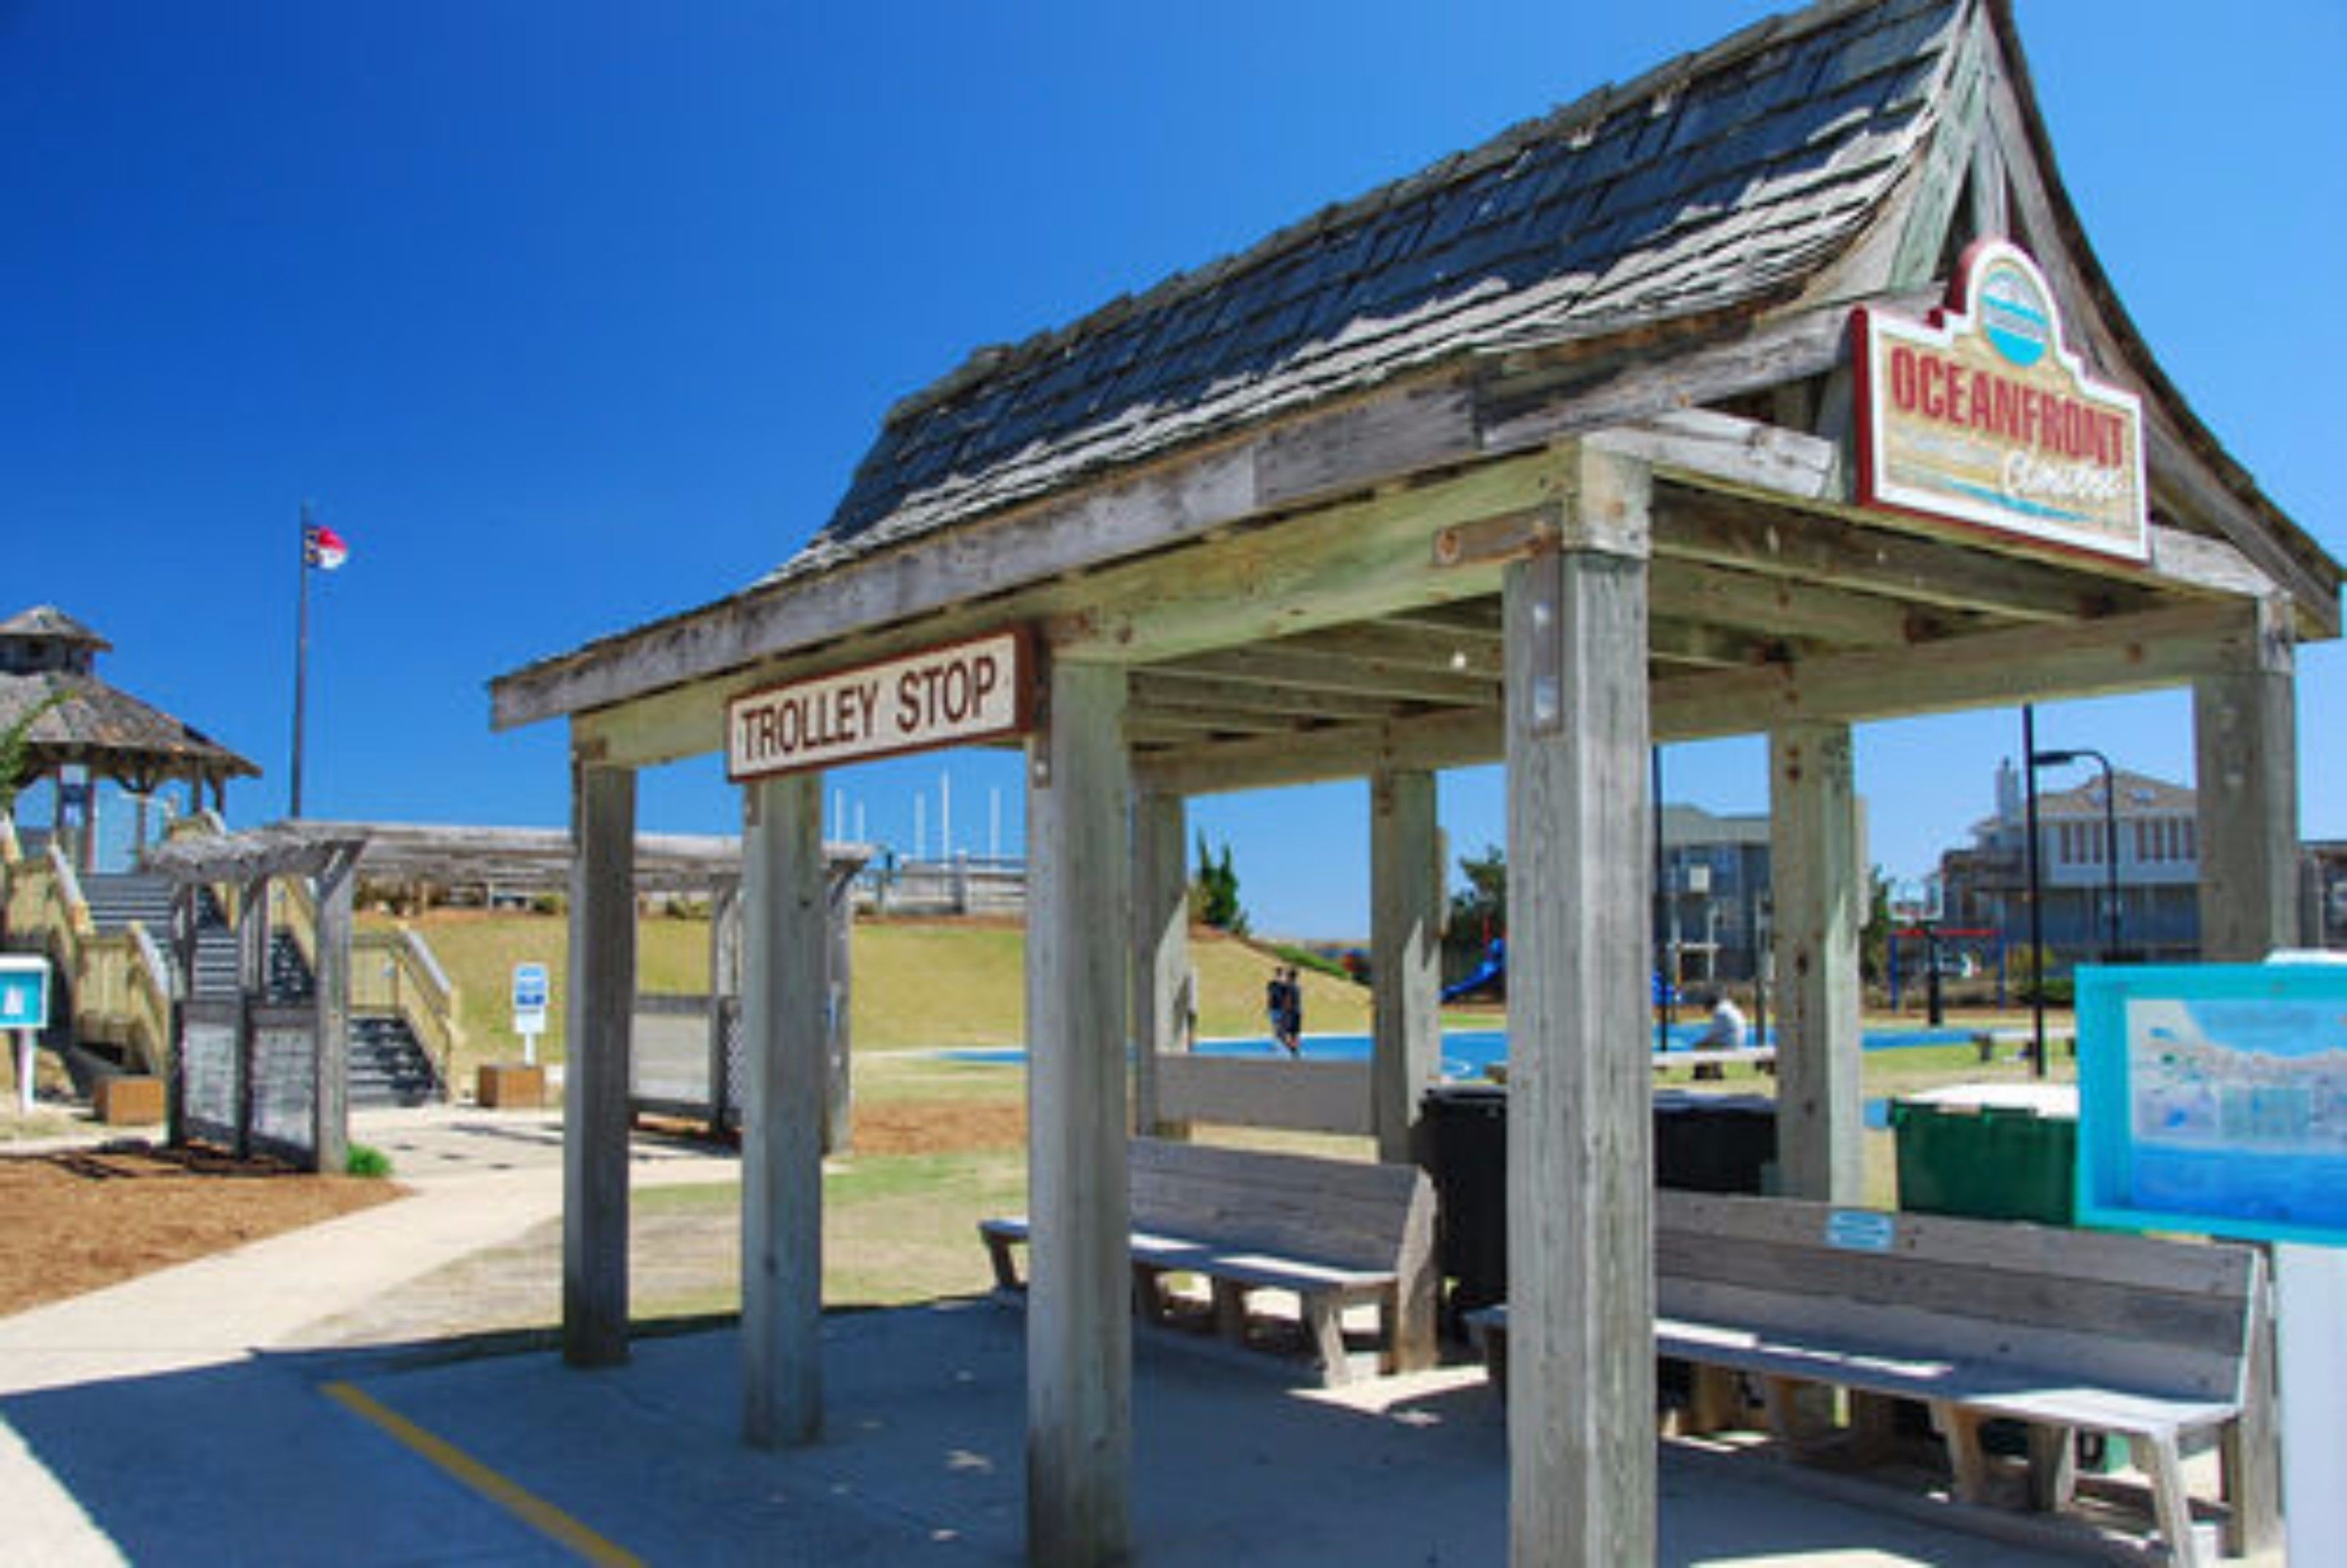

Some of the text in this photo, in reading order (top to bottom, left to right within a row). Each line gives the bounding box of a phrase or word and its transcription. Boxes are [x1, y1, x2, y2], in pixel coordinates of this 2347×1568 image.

[1891, 345, 2124, 469] OCEANFRONT
[741, 655, 997, 761] TROLLEY STOP
